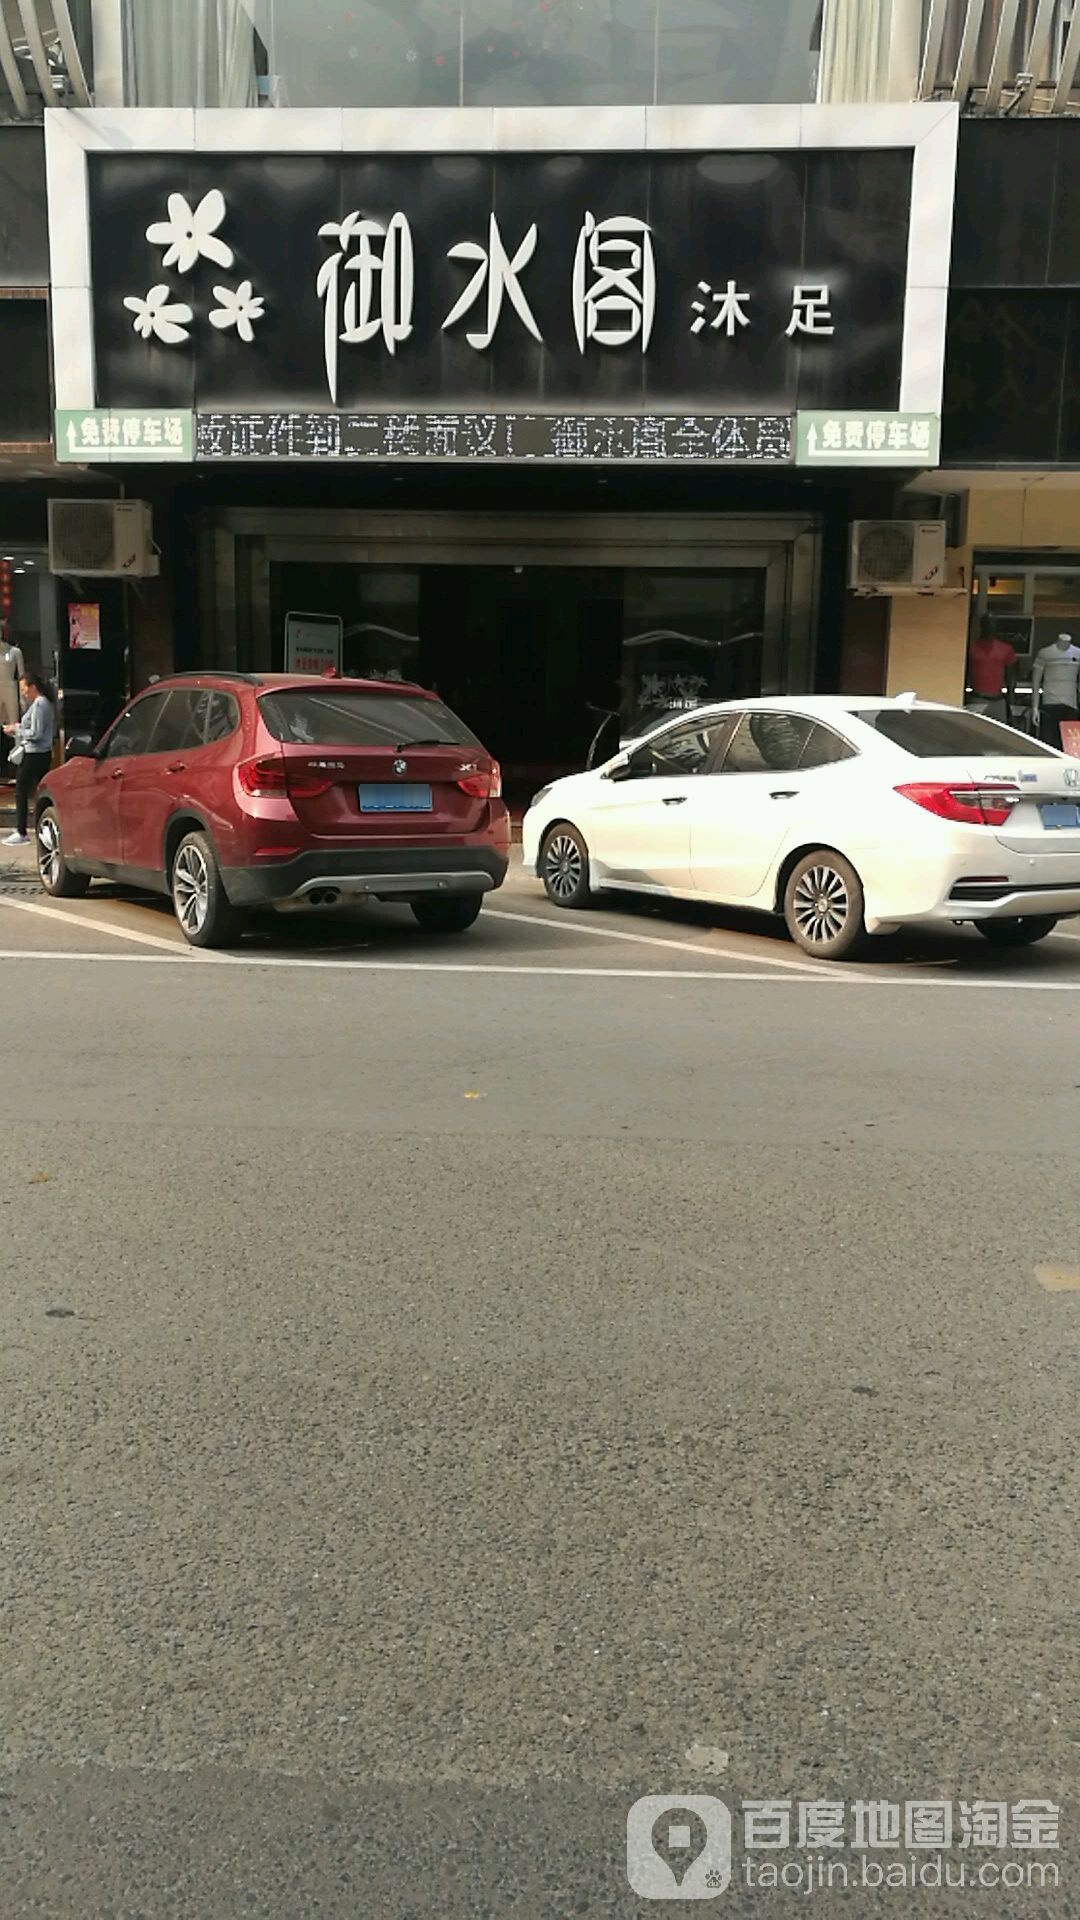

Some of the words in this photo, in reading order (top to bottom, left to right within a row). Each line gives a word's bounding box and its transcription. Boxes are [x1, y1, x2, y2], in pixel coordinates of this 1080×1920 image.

[317, 210, 656, 404] 御水阁
[690, 280, 836, 336] 沐足
[81, 417, 183, 446] 免费停车场
[822, 419, 930, 449] 免费停车场
